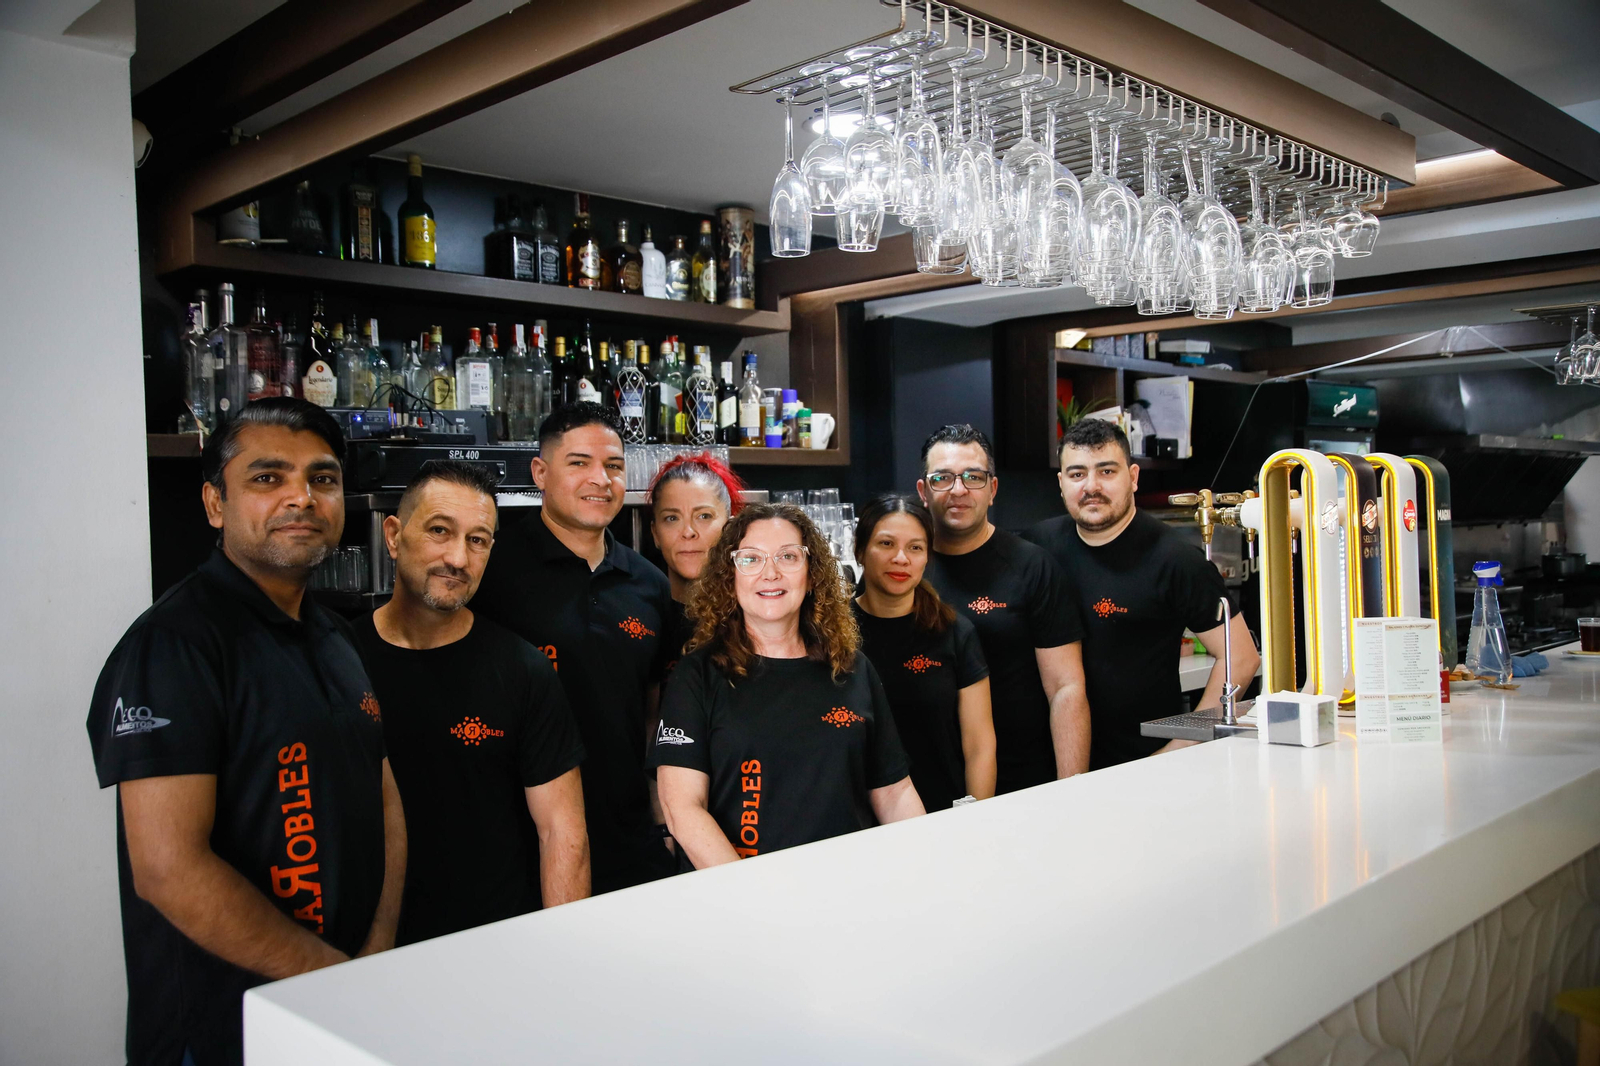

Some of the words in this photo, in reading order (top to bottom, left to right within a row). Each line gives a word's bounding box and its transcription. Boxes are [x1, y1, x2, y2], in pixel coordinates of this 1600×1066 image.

[448, 449, 464, 458] SPL
[465, 450, 480, 460] 400
[270, 741, 324, 935] AROBLES
